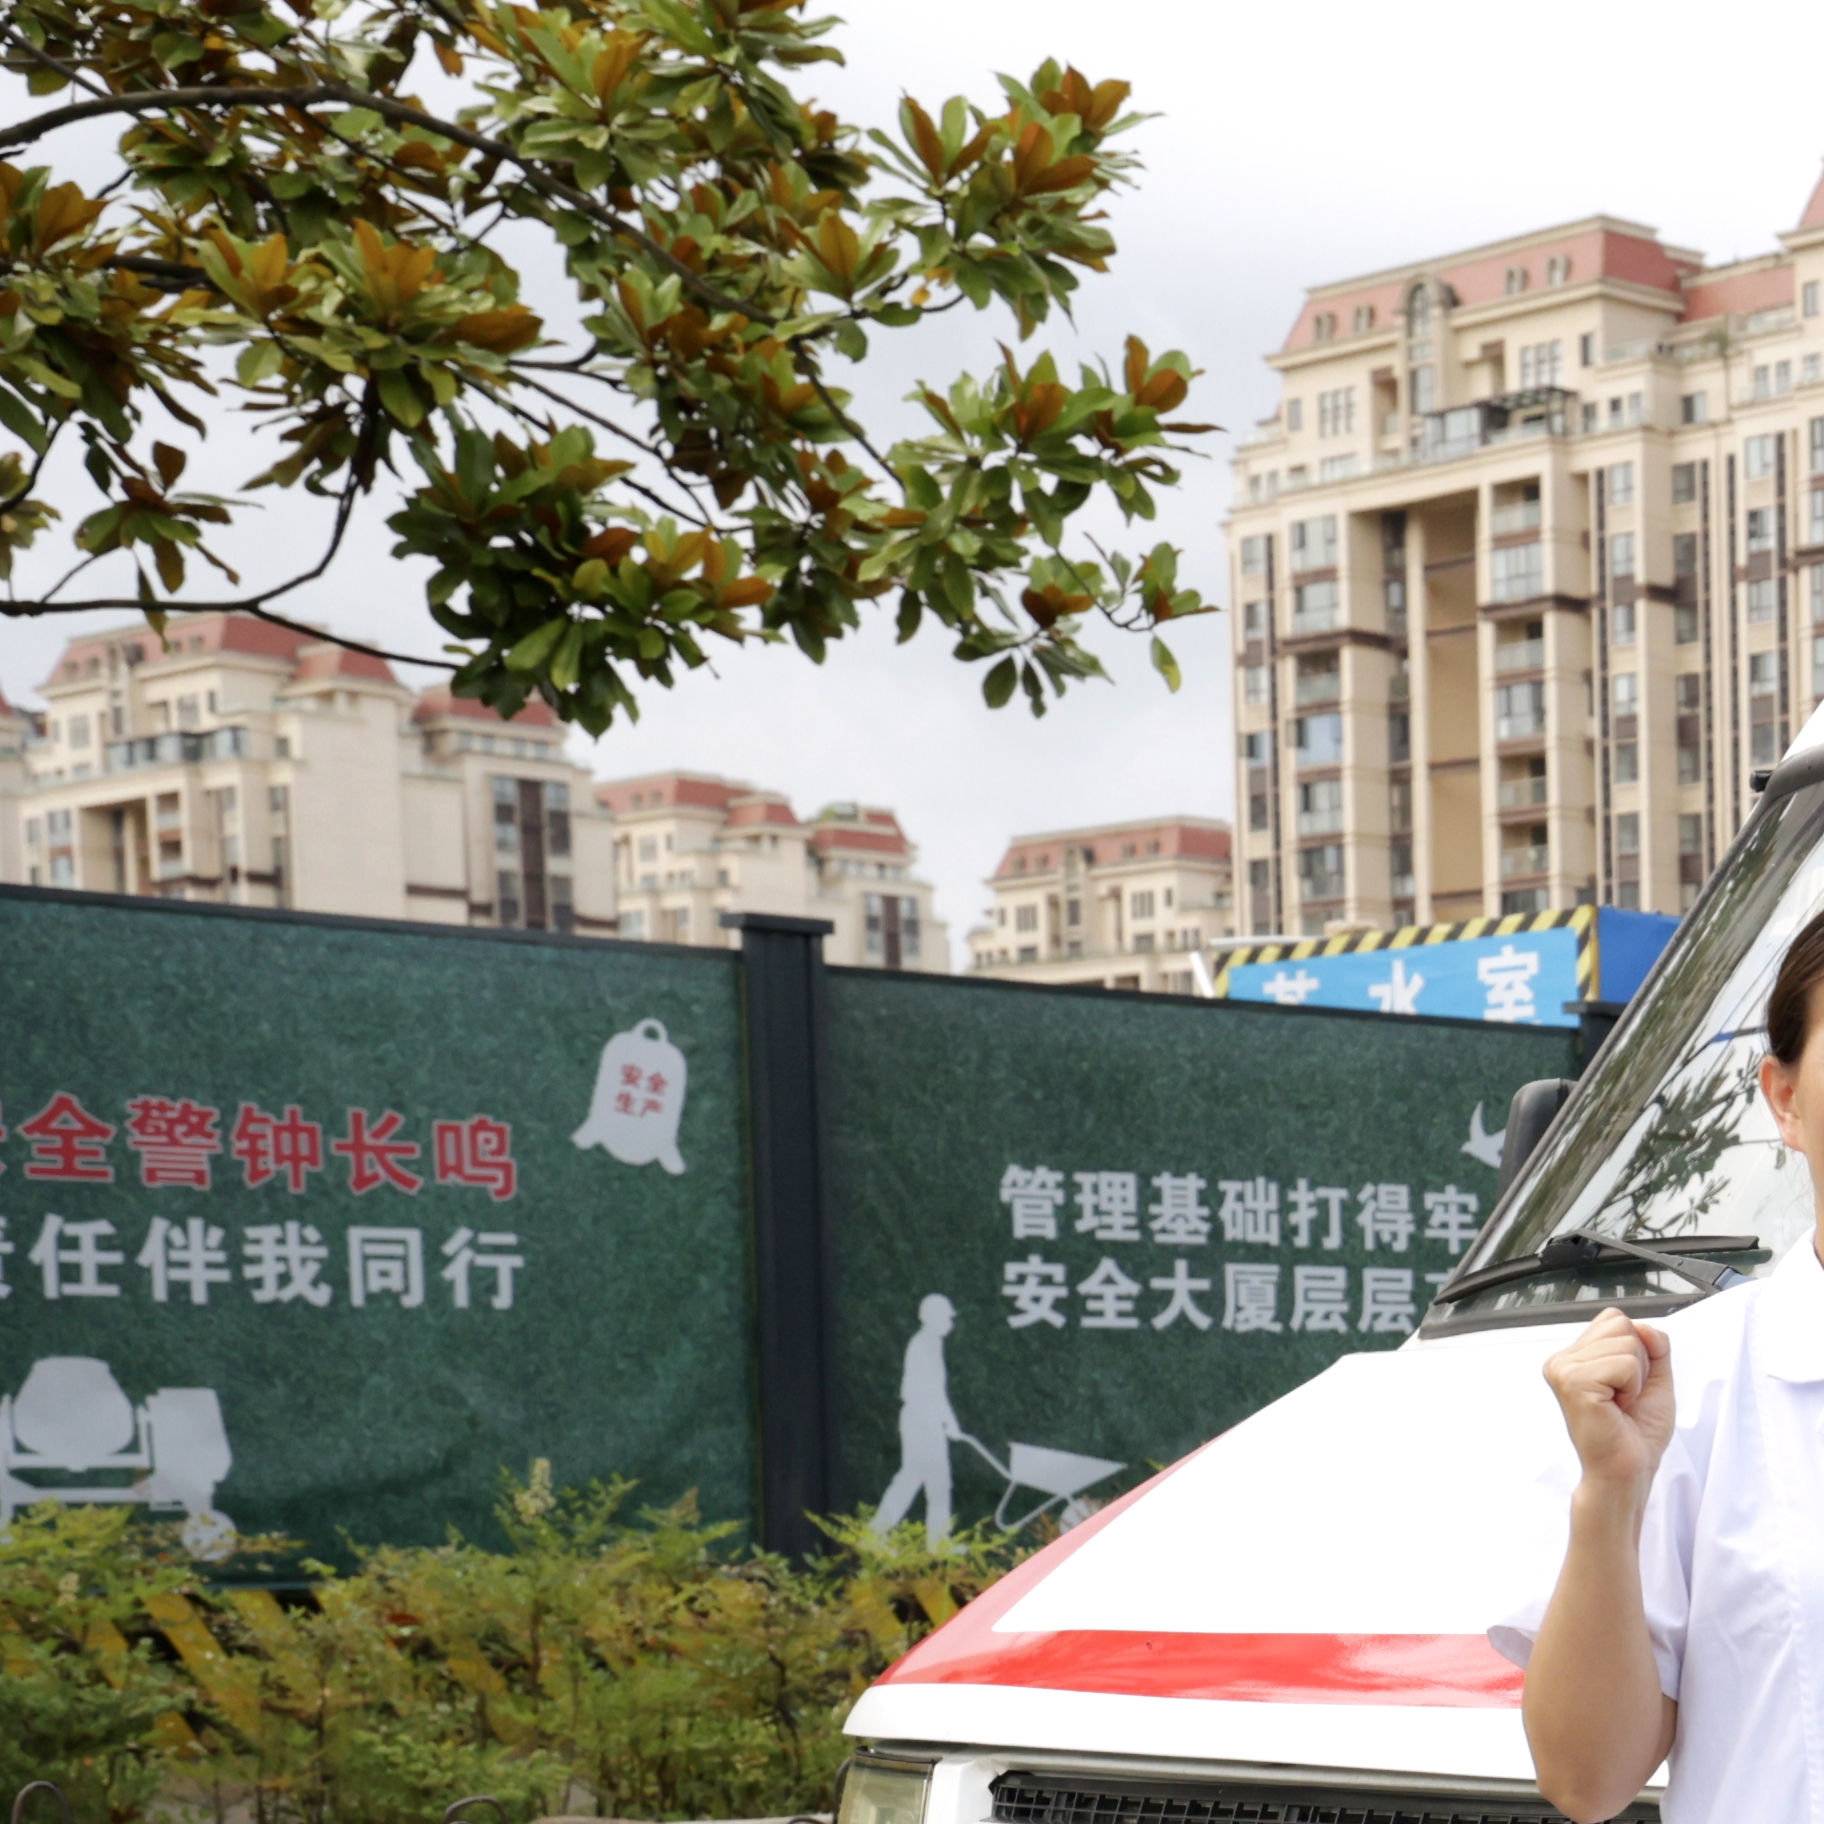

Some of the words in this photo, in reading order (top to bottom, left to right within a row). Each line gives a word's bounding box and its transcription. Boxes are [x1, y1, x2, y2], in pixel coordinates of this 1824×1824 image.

[0, 1091, 519, 1199] 全警钟长鸣
[1000, 1163, 1480, 1255] 管理基础打得牢
[0, 1212, 525, 1310] 任伴我同行
[1001, 1254, 1458, 1336] 安全大厦层层
